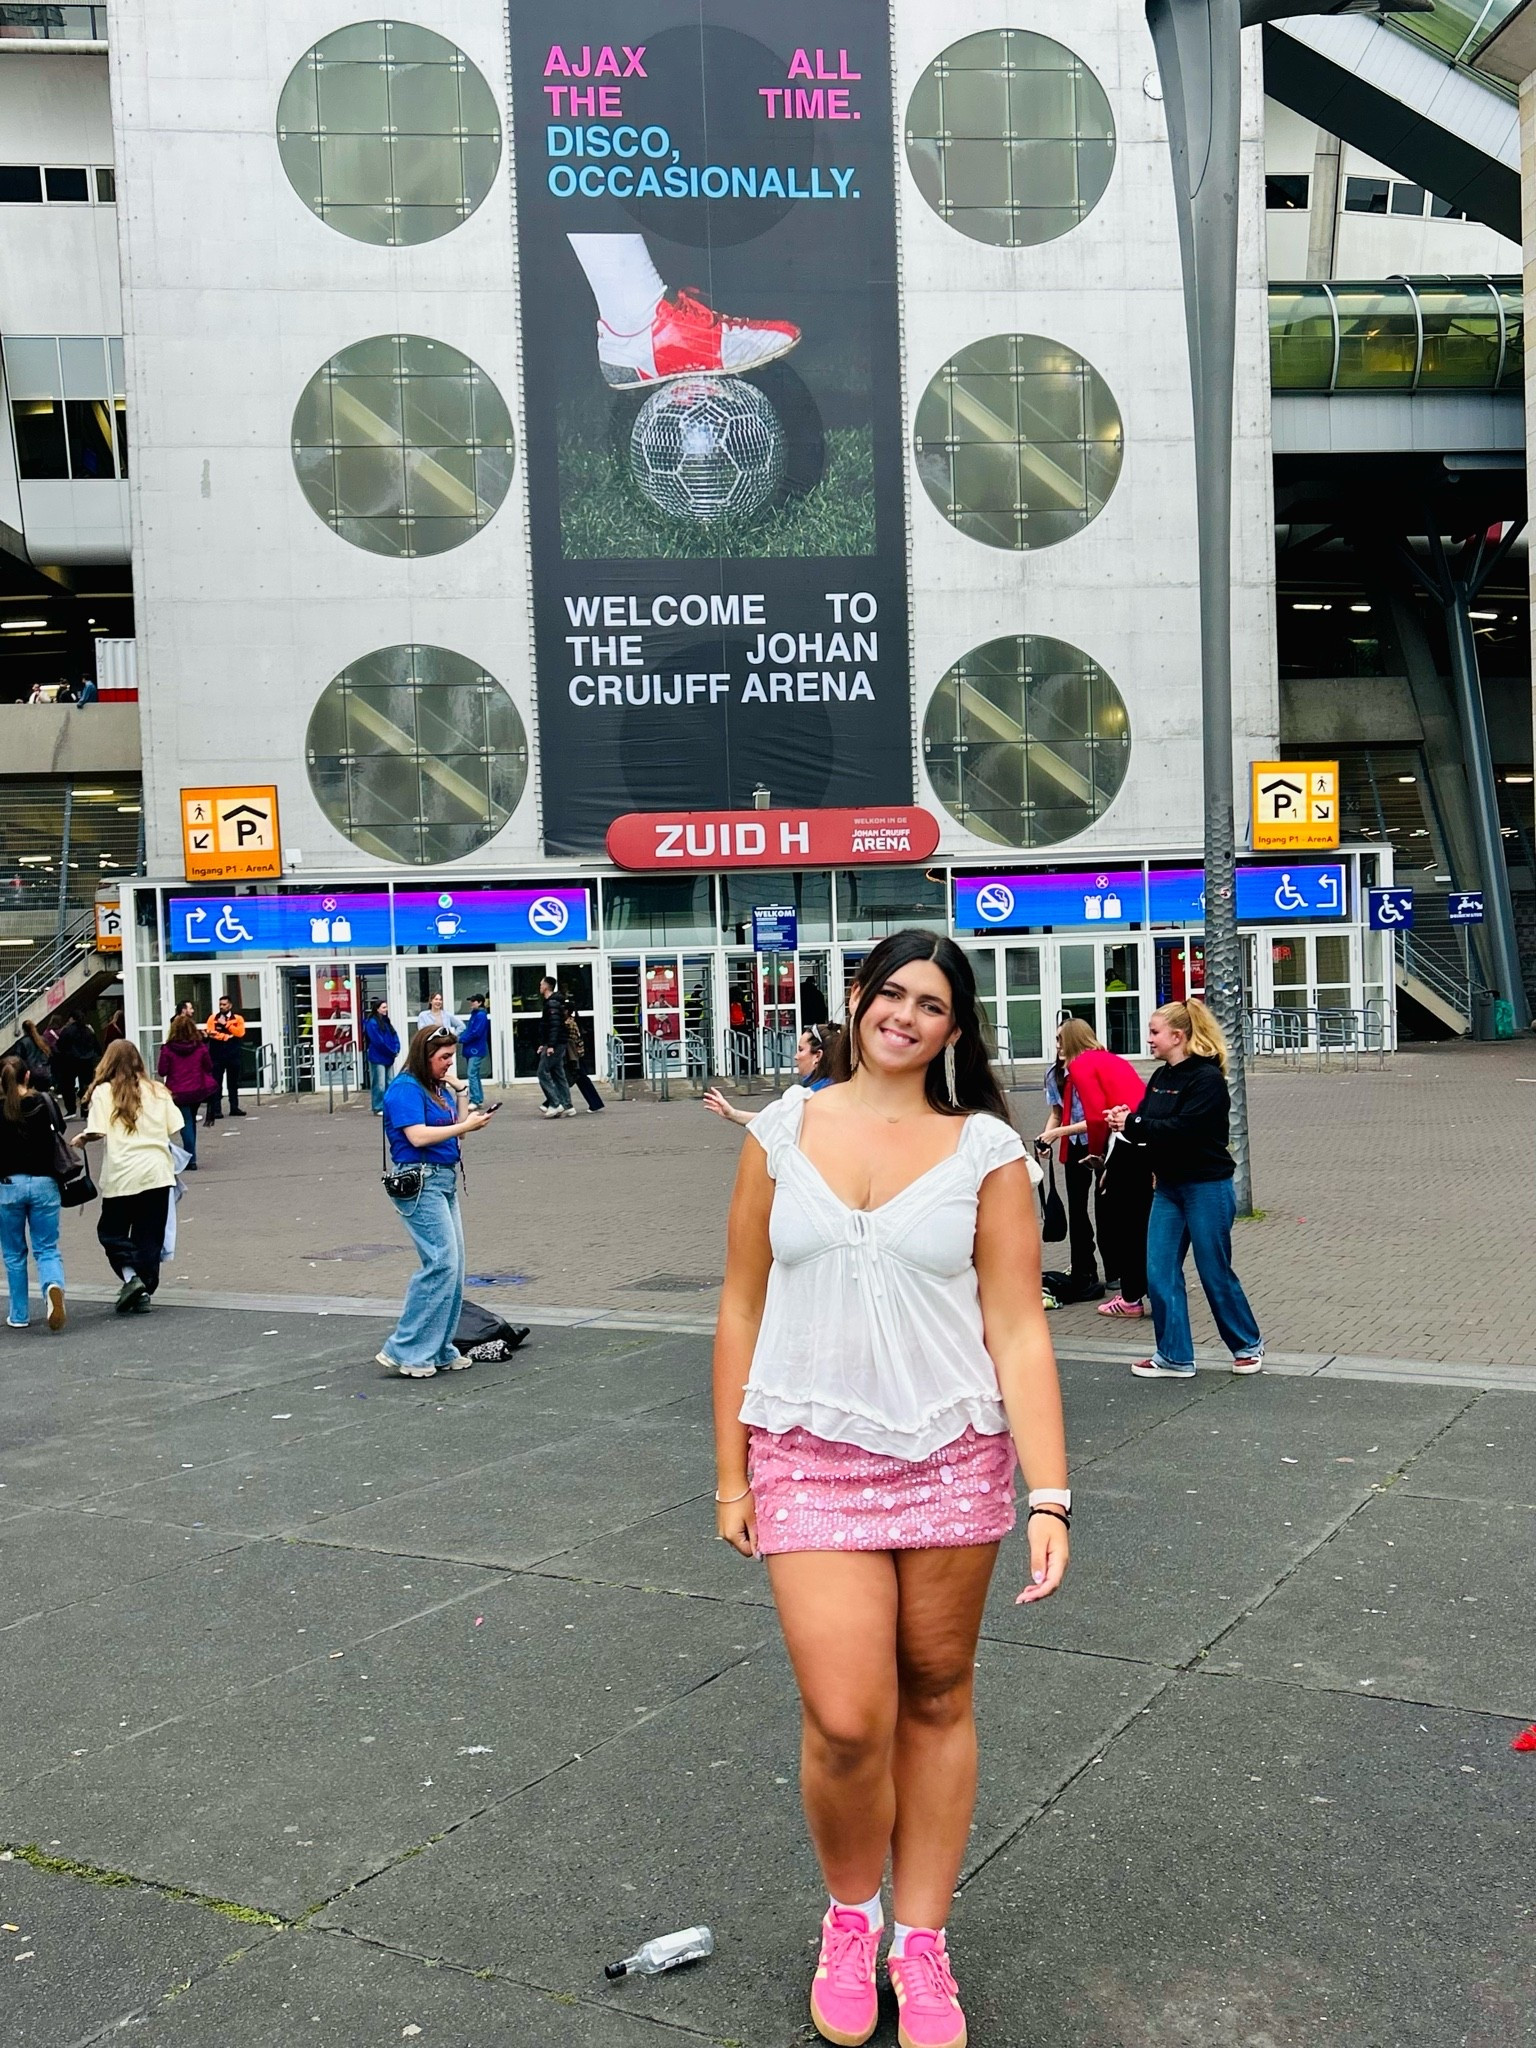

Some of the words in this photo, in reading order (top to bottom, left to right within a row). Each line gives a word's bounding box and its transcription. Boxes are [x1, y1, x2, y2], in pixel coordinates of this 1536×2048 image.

[543, 45, 648, 78] AJAX
[787, 48, 862, 80] ALL
[543, 85, 623, 118] THE
[758, 88, 861, 120] TIME.
[547, 125, 681, 164] DISCO,
[548, 165, 861, 199] OCCASIONALLY.
[563, 594, 767, 627] WELCOME
[825, 592, 878, 624] TO
[565, 635, 645, 667] THE
[746, 631, 879, 665] JOHAN
[568, 673, 731, 707] CRUIJFF
[740, 670, 876, 703] ARENA
[654, 823, 766, 858] ZUID
[779, 821, 810, 855] H
[852, 829, 879, 837] JOHAN
[852, 837, 911, 852] ARENA
[1258, 836, 1287, 845] Ingang
[191, 867, 223, 876] Ingang
[225, 865, 237, 873] P1
[246, 864, 275, 872] ArenA
[754, 909, 796, 918] WELKOM!
